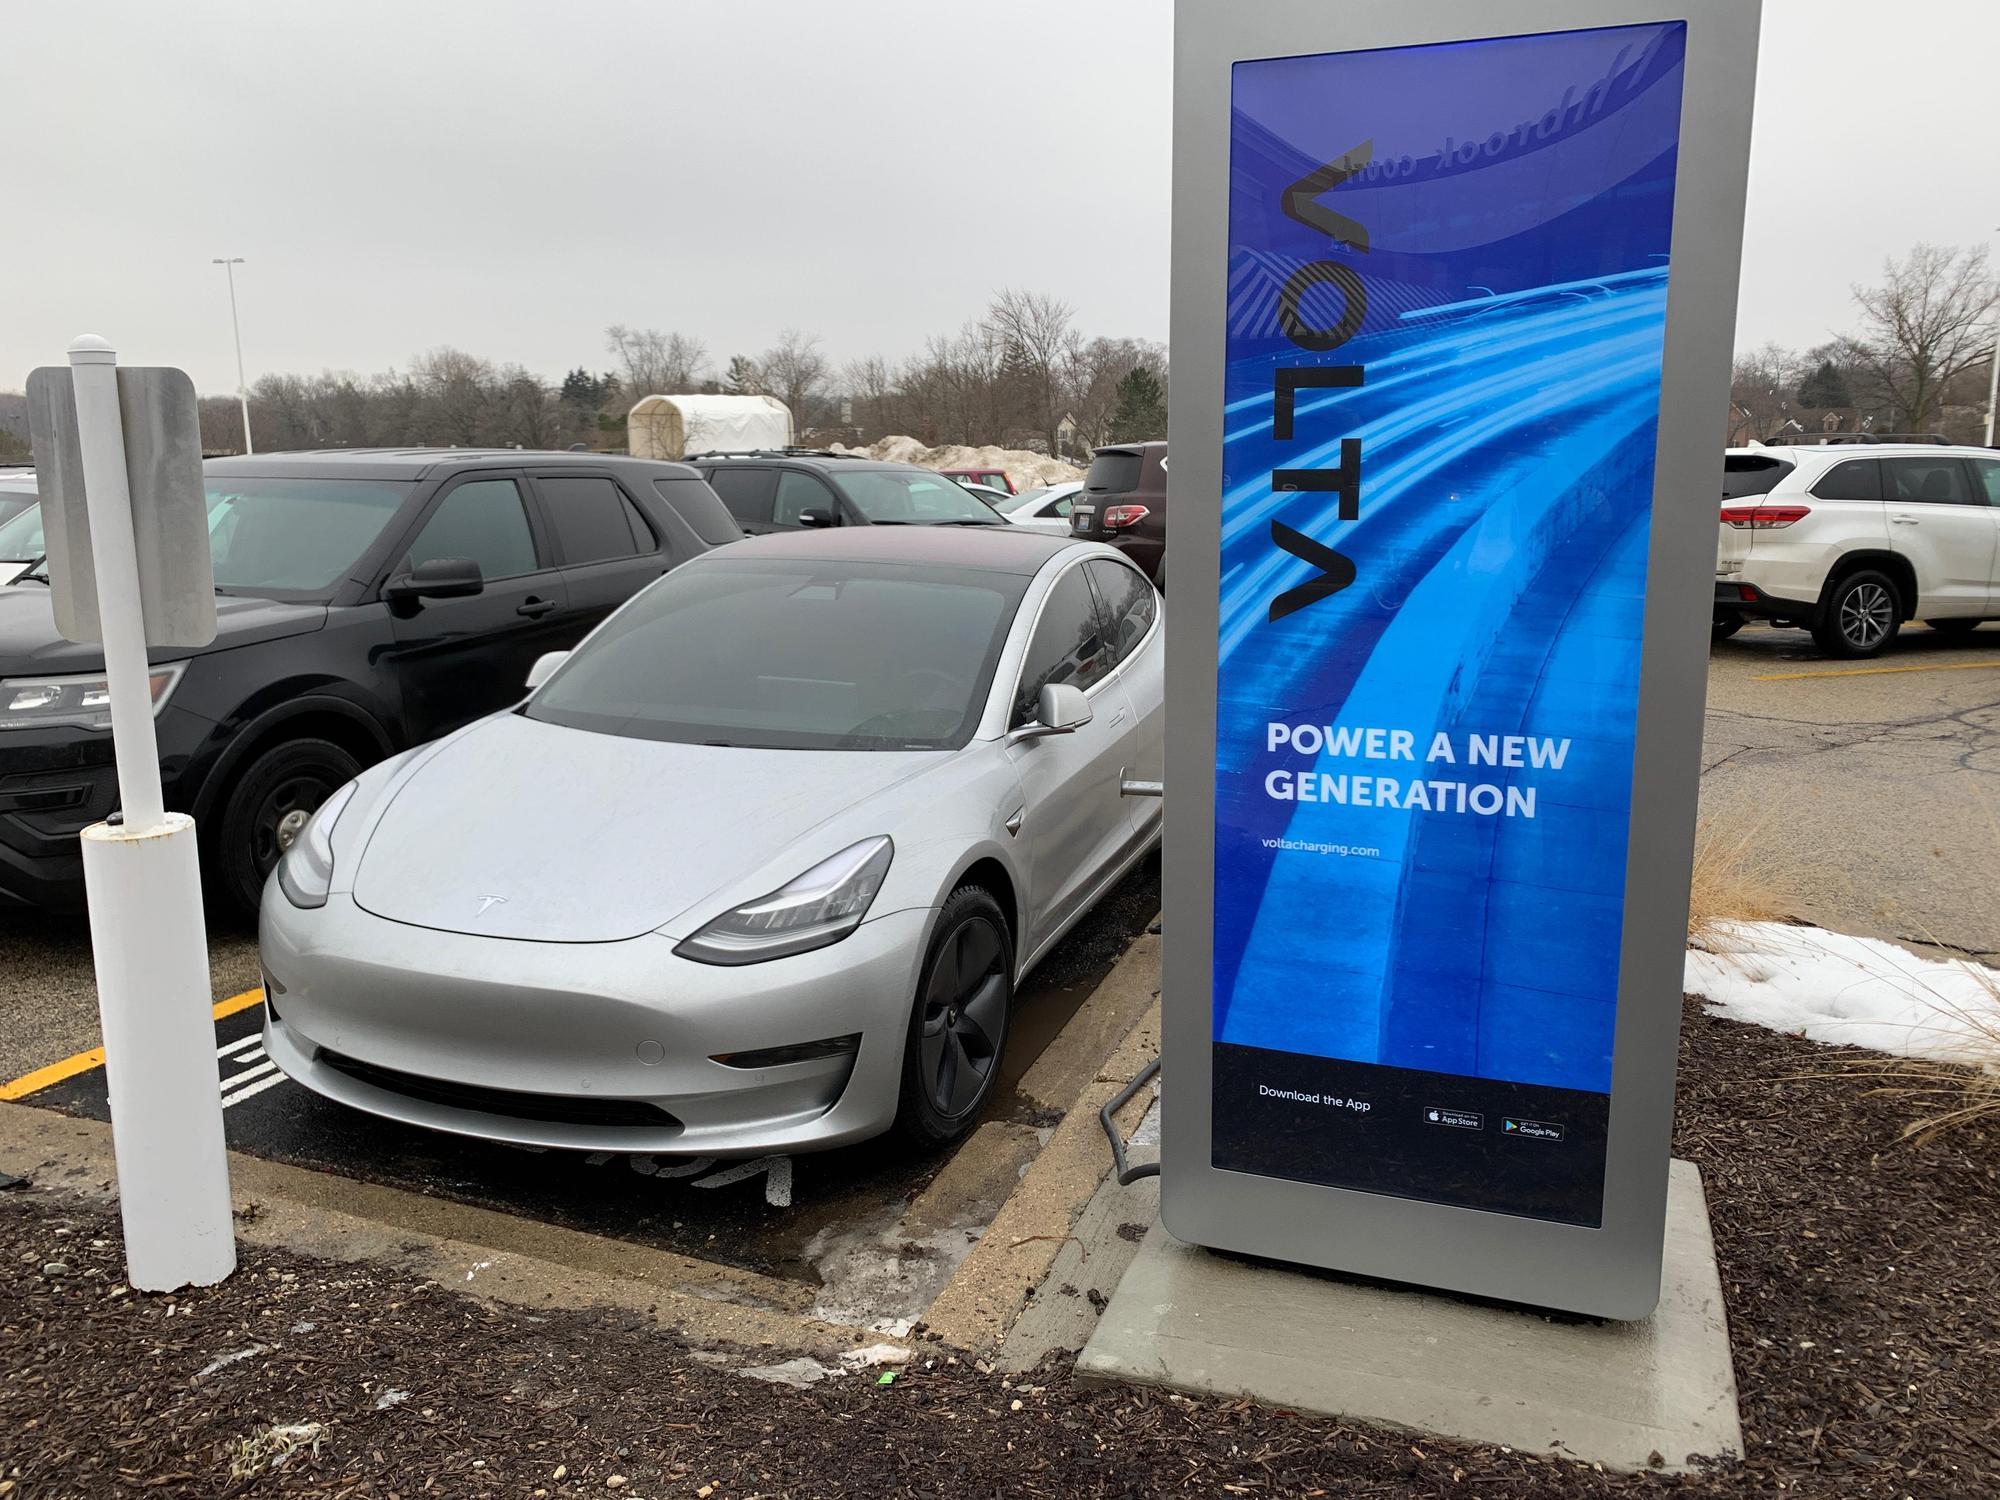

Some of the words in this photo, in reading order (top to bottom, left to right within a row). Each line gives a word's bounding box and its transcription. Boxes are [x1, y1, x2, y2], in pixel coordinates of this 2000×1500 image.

[1269, 138, 1374, 624] VOLTA
[1267, 722, 1415, 761] POWER
[1426, 733, 1456, 764] A
[1468, 734, 1571, 770] NEW
[1264, 770, 1537, 818] GENERATION
[1261, 838, 1380, 857] voltacharging.com
[1259, 1084, 1320, 1104] Download
[1323, 1095, 1343, 1107] the
[1345, 1098, 1371, 1112] App
[1441, 1115, 1458, 1125] App
[1458, 1117, 1479, 1127] Store
[1519, 1125, 1545, 1137] Google
[1545, 1129, 1560, 1139] Play
